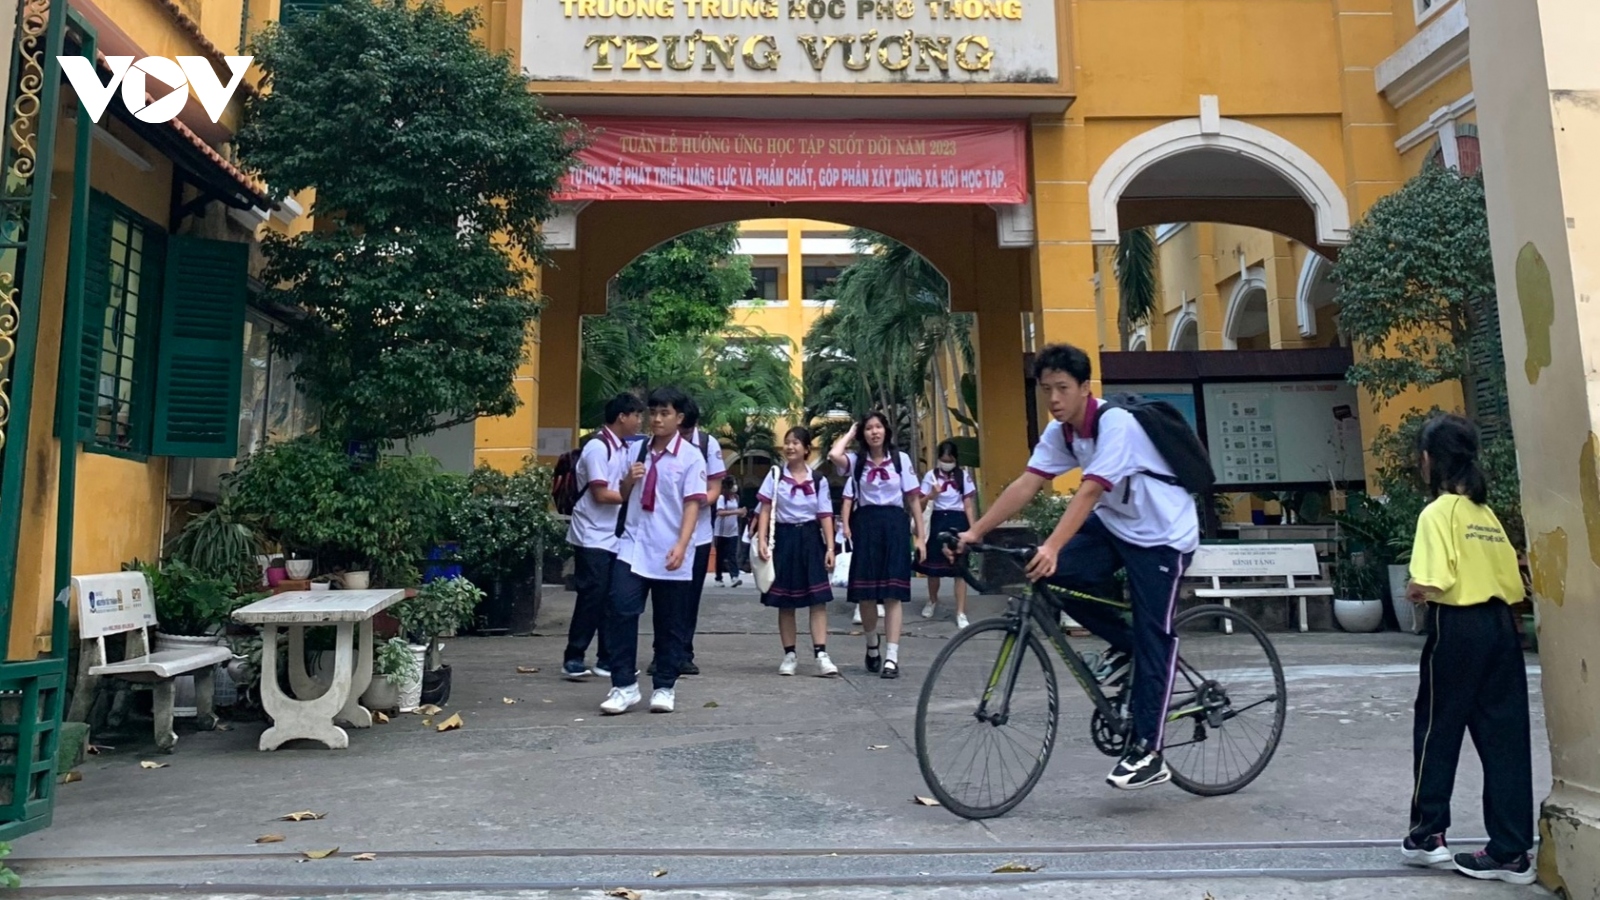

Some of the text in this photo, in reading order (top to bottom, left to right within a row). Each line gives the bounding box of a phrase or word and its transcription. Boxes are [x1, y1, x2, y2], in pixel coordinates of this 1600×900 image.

[683, 0, 779, 18] TRUNG
[788, 0, 846, 23] HỌC
[584, 28, 994, 71] TRƯNG VƯƠNG
[620, 129, 957, 158] TUẦN LỄ HƯỞNG ỨNG HỌC TẬP SUỐT ĐỜI NĂM 2023
[585, 165, 607, 192] HỌC
[608, 157, 623, 186] ĐỂ
[624, 161, 652, 186] PHÁT
[653, 157, 684, 186] TRIỂN
[686, 163, 715, 187] NĂNG
[717, 163, 738, 192] LỰC
[739, 161, 754, 187] VÀ
[755, 158, 785, 187] PHẨM
[786, 159, 817, 191] CHẤT,
[818, 162, 840, 188] GÓP
[871, 163, 893, 188] XÂY
[894, 165, 923, 194] DỰNG
[924, 163, 939, 188] XÃ
[940, 165, 959, 194] HỘI
[961, 168, 983, 194] HỌC
[985, 165, 1007, 194] TẬP.
